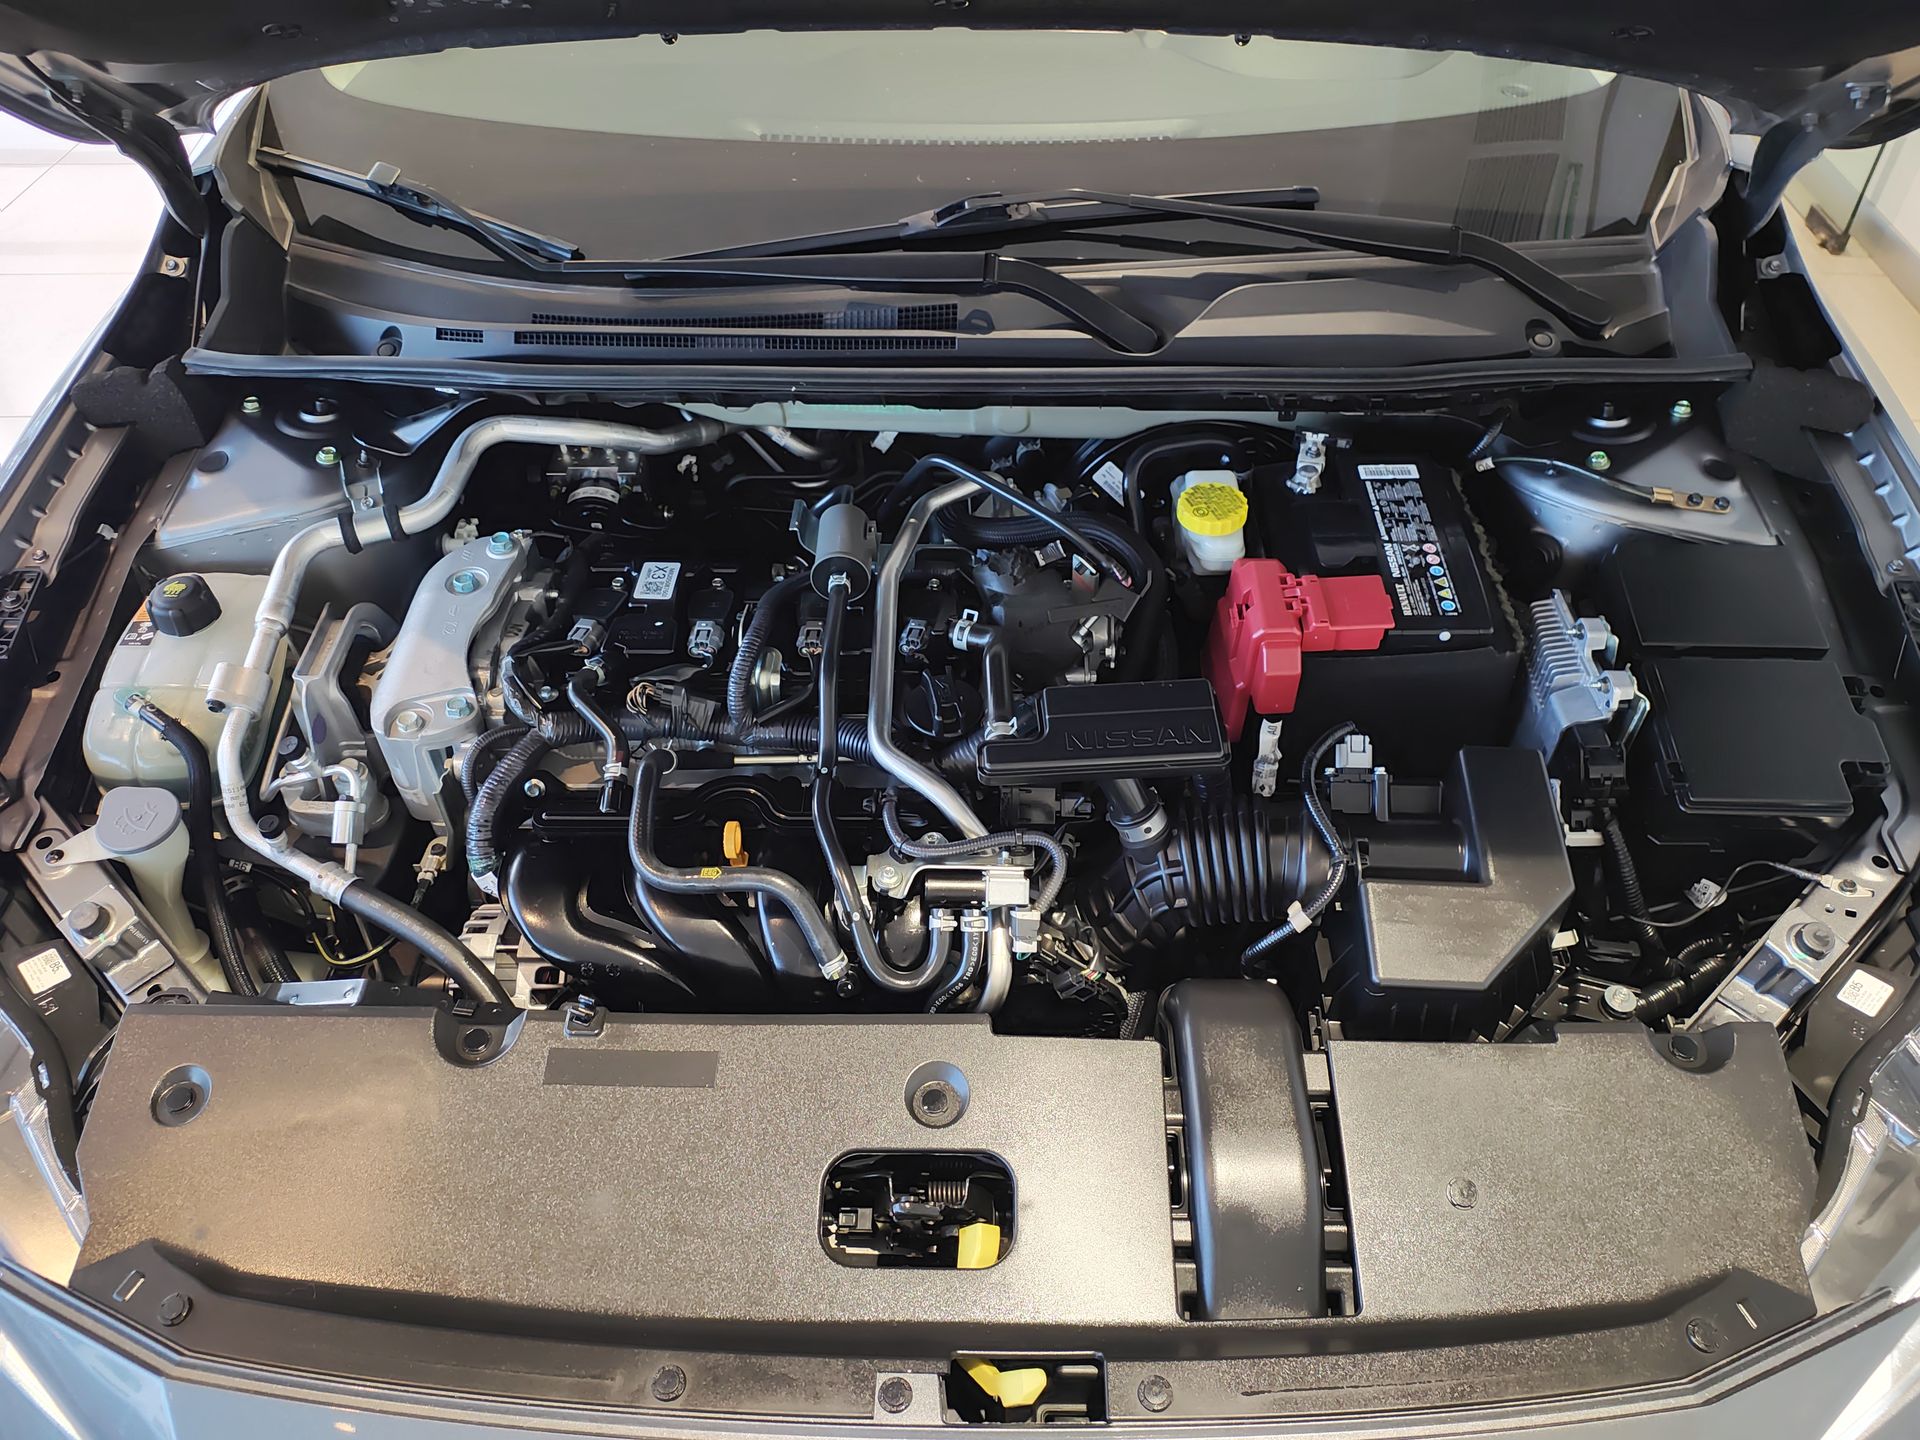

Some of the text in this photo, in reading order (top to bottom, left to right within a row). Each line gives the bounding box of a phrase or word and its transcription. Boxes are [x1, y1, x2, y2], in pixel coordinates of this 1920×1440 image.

[652, 565, 668, 579] X3
[1384, 542, 1402, 578] NISSAN
[1395, 582, 1412, 616] RENAULT
[1064, 724, 1213, 751] NISSAN
[1849, 980, 1863, 992] B5
